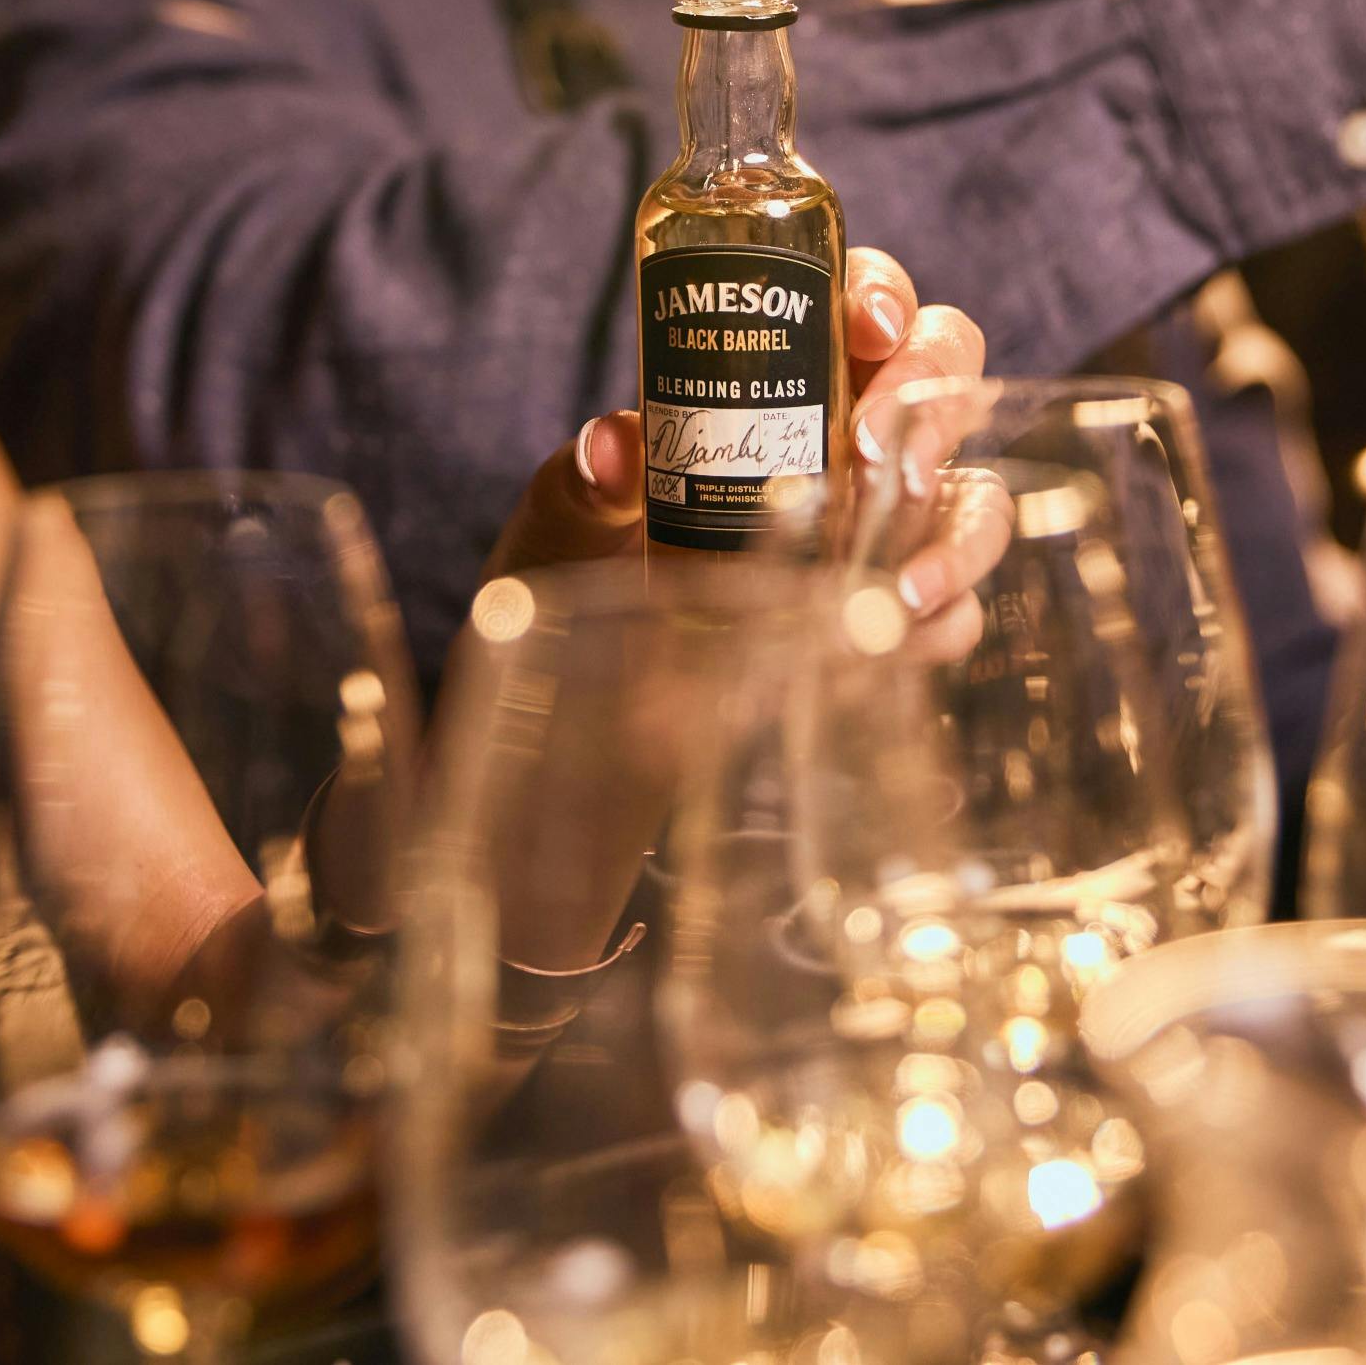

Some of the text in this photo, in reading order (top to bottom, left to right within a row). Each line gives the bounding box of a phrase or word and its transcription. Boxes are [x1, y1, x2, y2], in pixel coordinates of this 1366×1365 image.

[654, 282, 811, 325] JAMESON
[668, 327, 791, 351] BLACK BARREL
[657, 375, 806, 399] BLENDING CLASS
[648, 404, 679, 418] BLENDED
[695, 483, 774, 493] TRIPLE DISTILLED
[700, 494, 769, 503] IRISH WHISKEY
